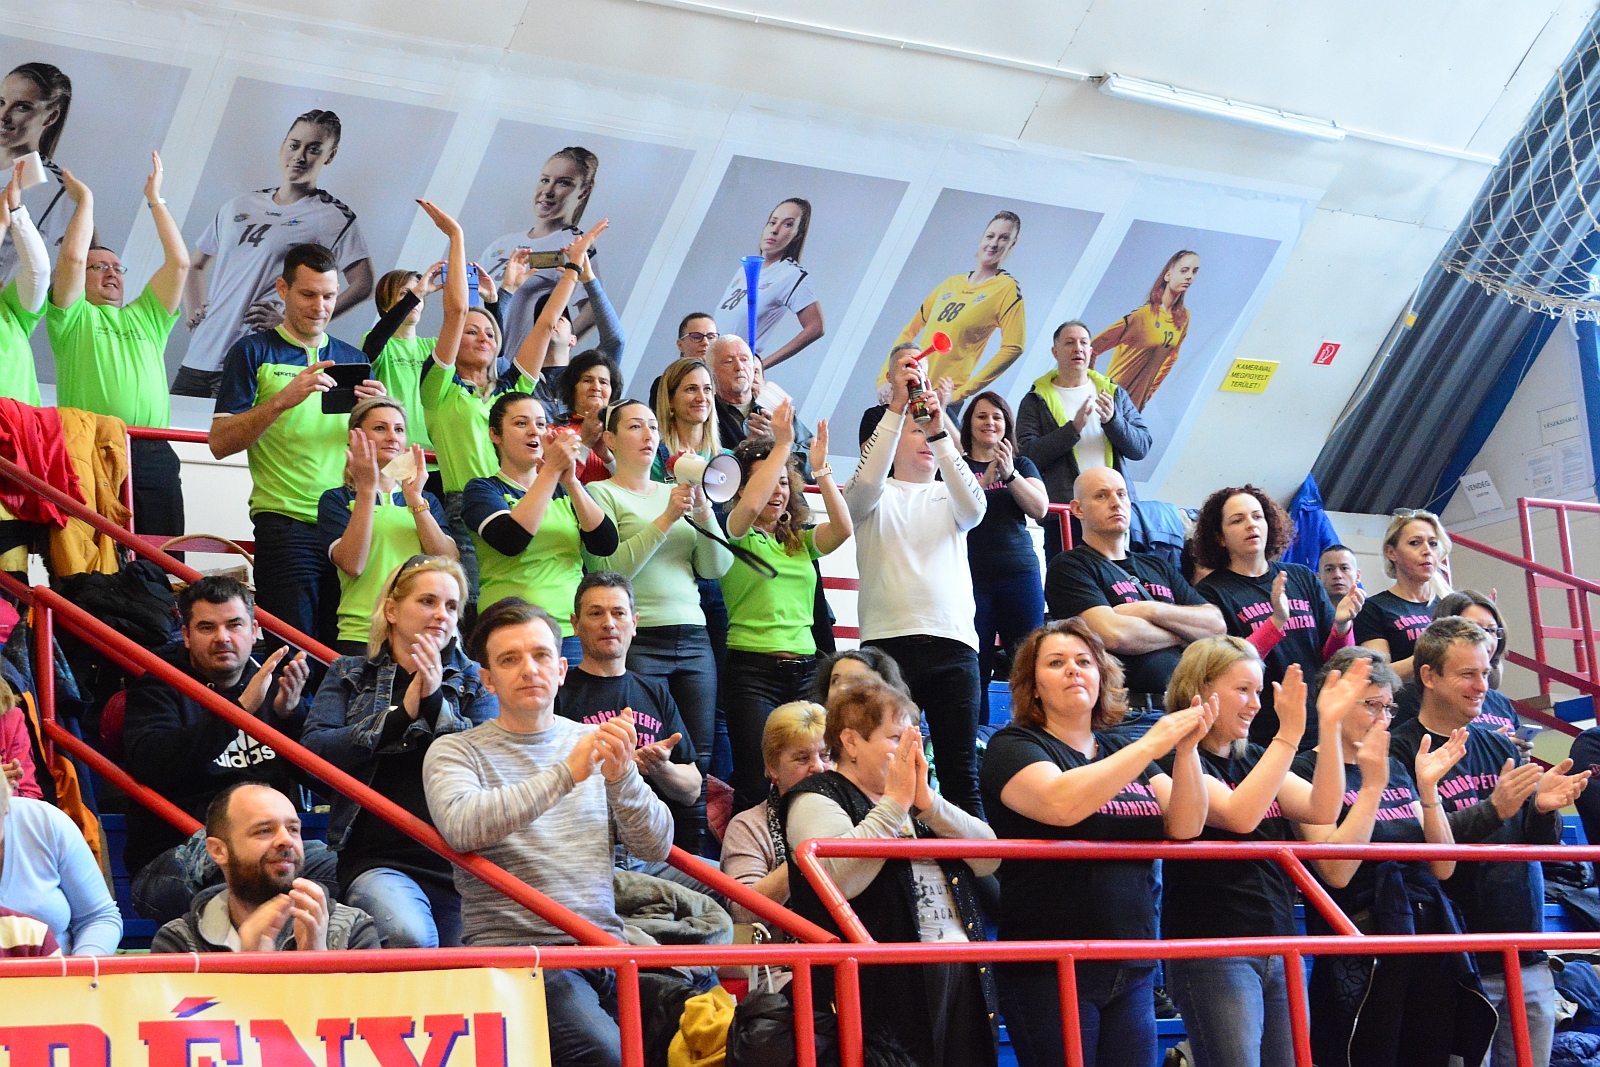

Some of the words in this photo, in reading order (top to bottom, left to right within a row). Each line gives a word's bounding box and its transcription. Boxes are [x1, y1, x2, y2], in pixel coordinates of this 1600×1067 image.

[238, 223, 272, 247] 14
[721, 288, 748, 310] 28
[937, 302, 966, 322] 88
[1162, 330, 1174, 348] 12
[1465, 480, 1491, 492] VENDÉG
